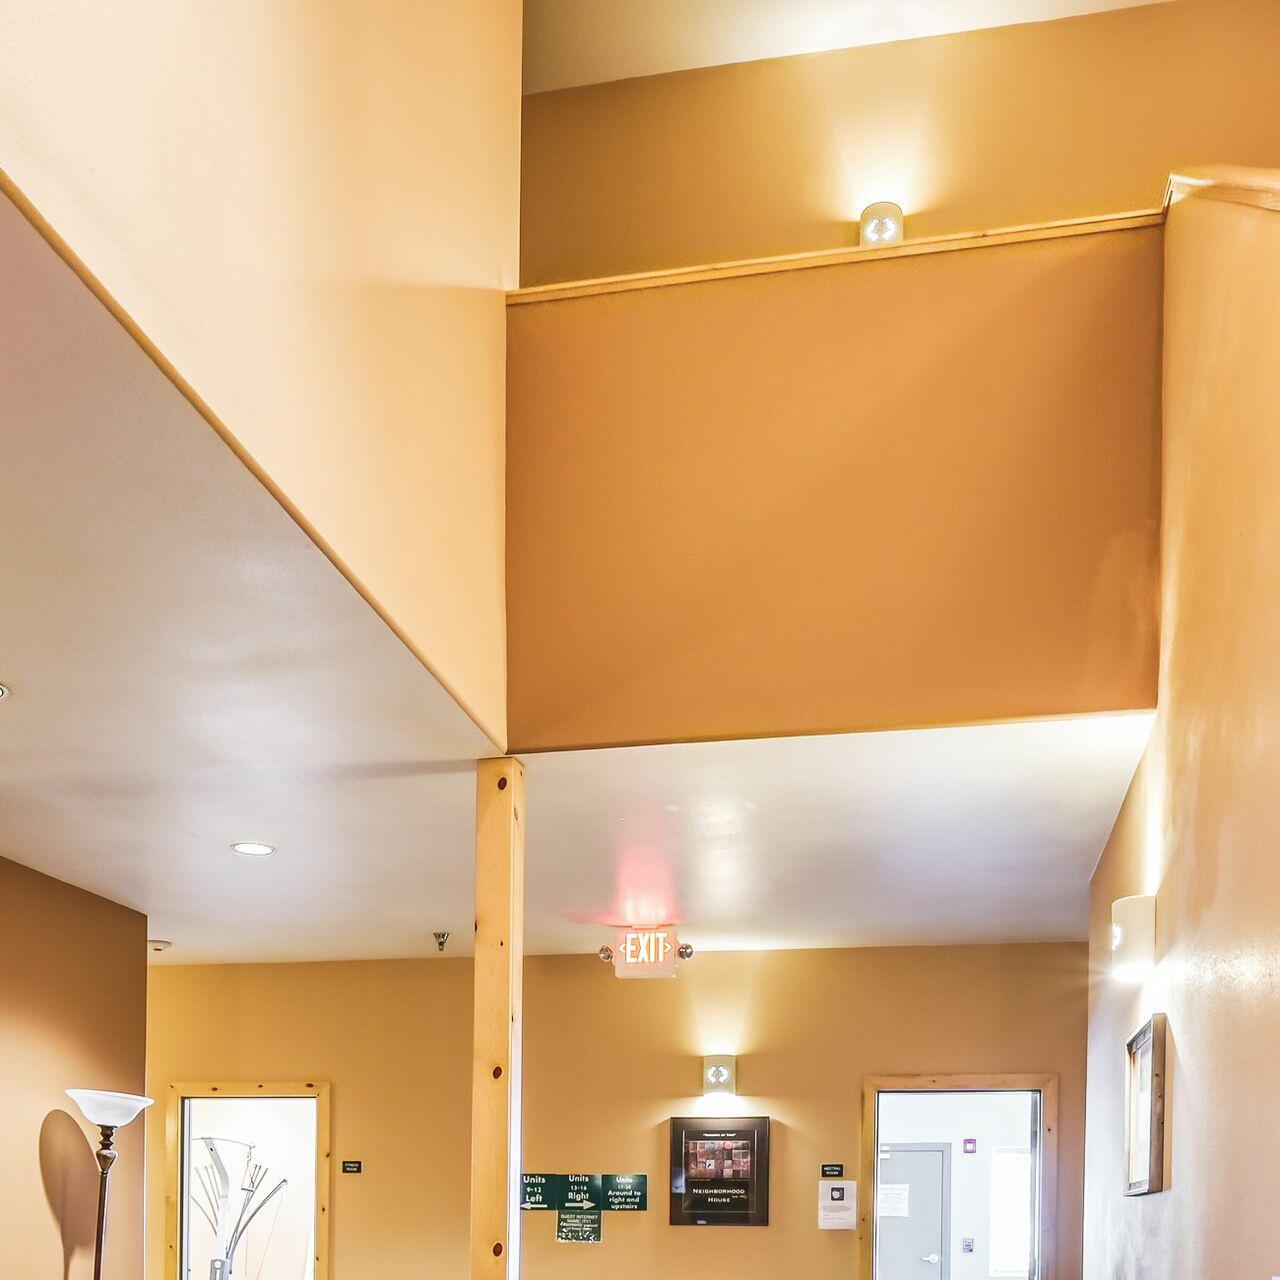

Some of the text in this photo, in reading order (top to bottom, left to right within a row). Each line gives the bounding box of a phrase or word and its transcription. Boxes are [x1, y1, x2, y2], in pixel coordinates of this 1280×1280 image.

[625, 932, 667, 963] EXIT
[523, 1175, 546, 1184] Units
[568, 1174, 589, 1182] Units
[568, 1192, 589, 1201] Right
